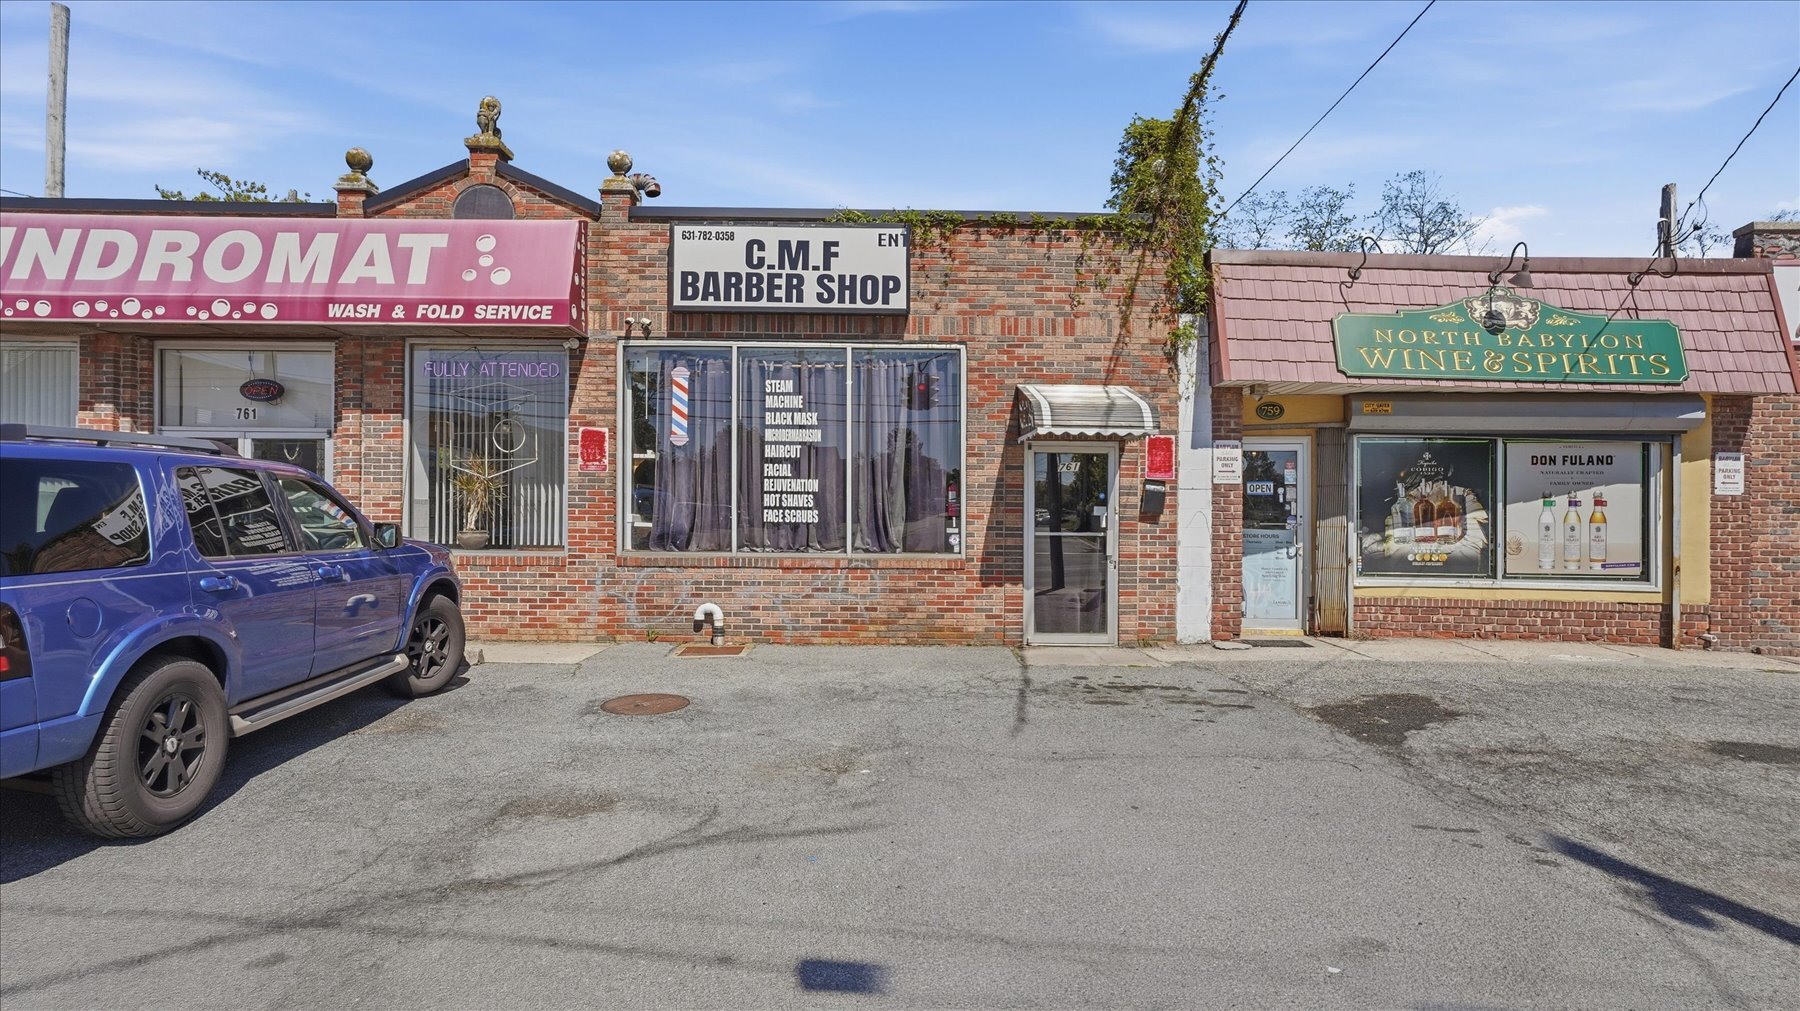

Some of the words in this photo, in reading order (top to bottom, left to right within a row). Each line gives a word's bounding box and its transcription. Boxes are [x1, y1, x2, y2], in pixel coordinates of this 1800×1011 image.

[681, 230, 735, 241] 631-782-0358
[745, 238, 840, 271] C.M.F
[680, 271, 805, 303] BARBER
[816, 273, 901, 305] SHOP
[328, 304, 381, 318] WASH
[392, 304, 405, 319] &
[416, 304, 464, 319] FOLD
[474, 305, 553, 320] SERVICE
[1375, 329, 1482, 346] NORTH
[1497, 332, 1644, 349] BABYLON
[1358, 347, 1475, 372] WINE
[1483, 349, 1506, 374] &
[1512, 352, 1671, 377] SPIRITS
[423, 361, 469, 377] FULLY
[479, 362, 560, 378] ATTENDED
[245, 385, 278, 396] OPEN
[765, 380, 793, 392] STEAM
[765, 395, 803, 408] MACHINE
[236, 408, 257, 420] 761
[1261, 406, 1280, 416] 759
[765, 411, 792, 425] BLACK
[793, 412, 818, 425] MASK
[765, 444, 801, 458] HAIRCUT
[1059, 463, 1078, 471] 761
[1531, 455, 1557, 466] DON
[1562, 455, 1614, 466] FULANO
[764, 463, 792, 476] FACIAL
[764, 479, 819, 492] REJUVENATION
[1249, 484, 1272, 493] OPEN
[763, 494, 780, 507] HOT
[781, 494, 814, 507] SHAVES
[763, 509, 783, 522] FACE
[784, 510, 819, 523] SCRUBS
